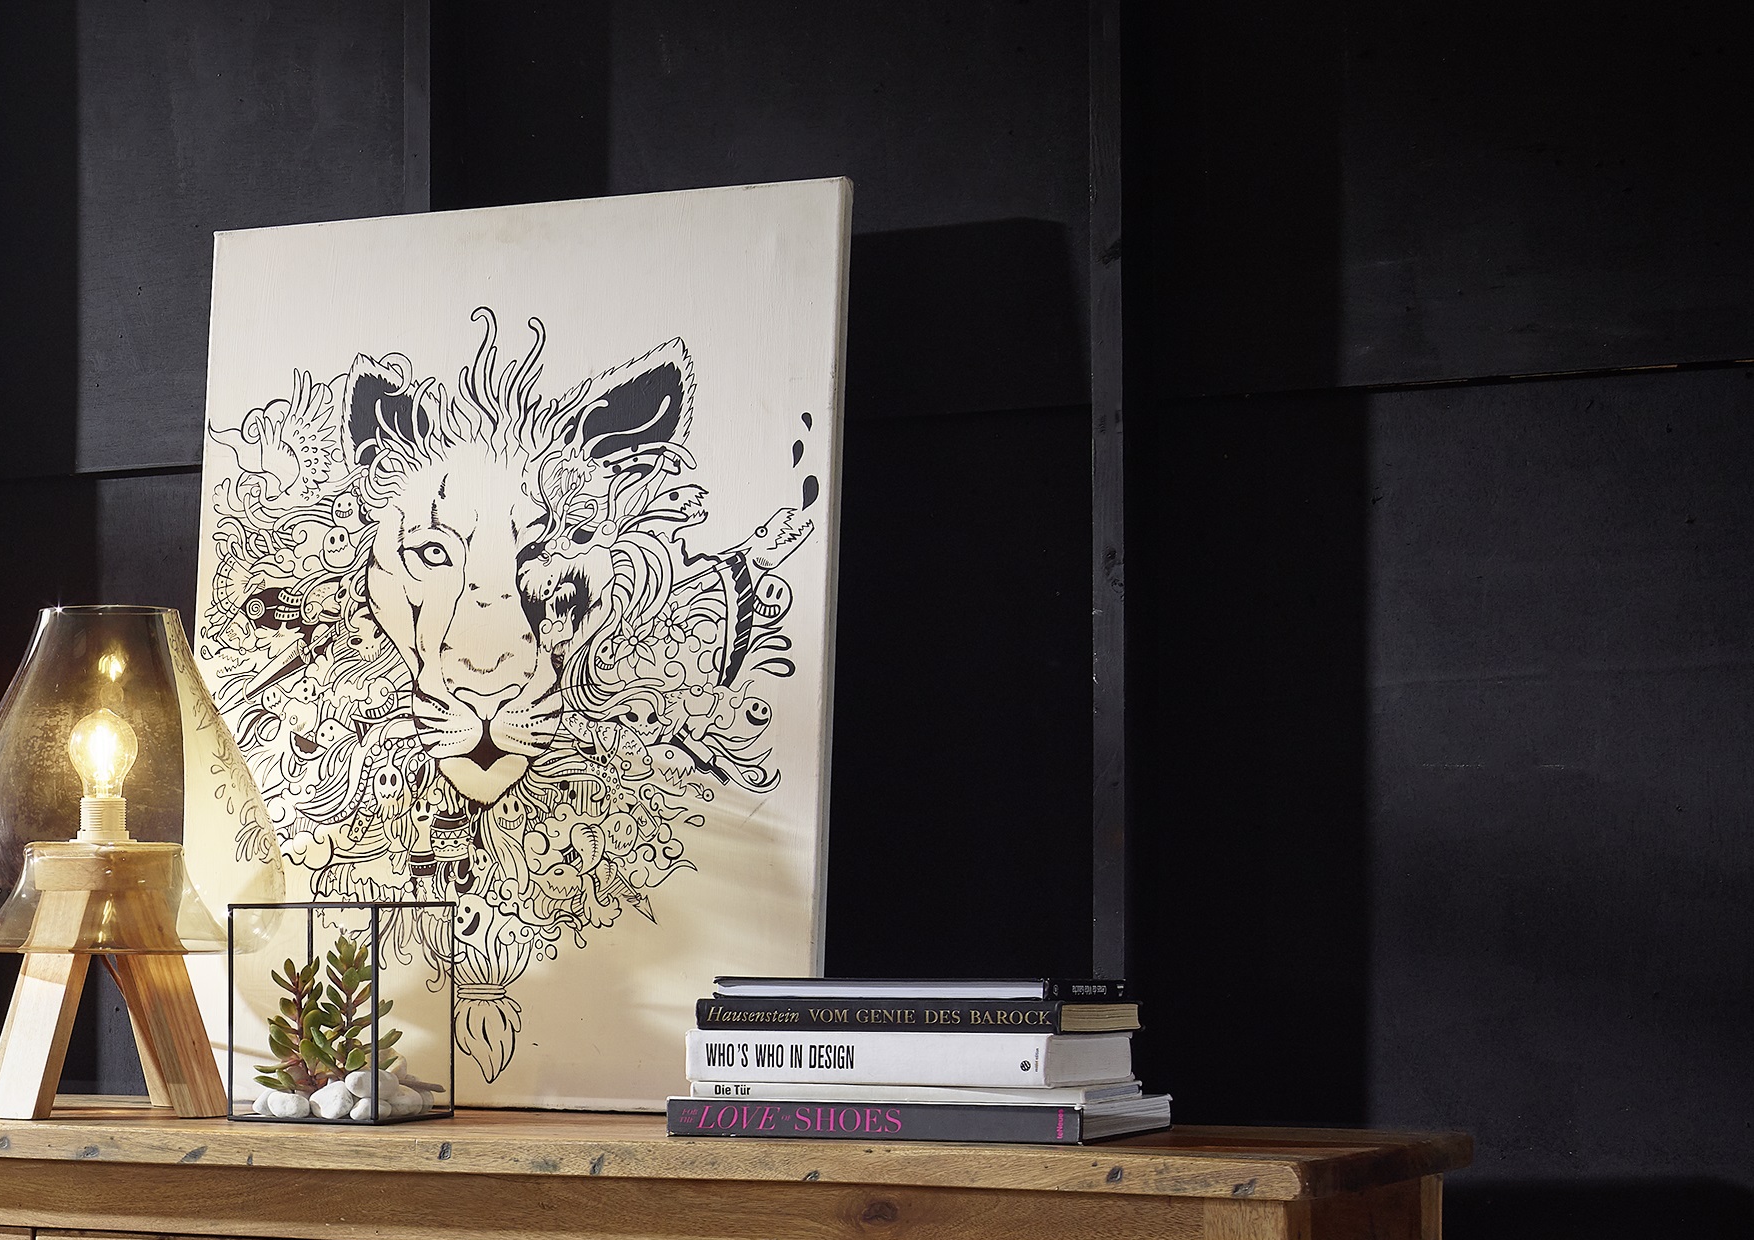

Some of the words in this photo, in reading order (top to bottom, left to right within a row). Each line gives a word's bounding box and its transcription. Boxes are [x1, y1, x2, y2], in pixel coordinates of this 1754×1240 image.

[706, 1005, 800, 1024] Hausenstein
[808, 1008, 849, 1024] VOM
[855, 1008, 917, 1025] GENIE
[924, 1009, 962, 1025] DES
[969, 1009, 1053, 1026] BAROCK
[705, 1042, 749, 1068] WHO'S
[754, 1043, 785, 1069] WHO
[789, 1044, 804, 1069] IN
[808, 1044, 855, 1070] DESIGN
[714, 1084, 732, 1096] Die
[733, 1084, 751, 1096] Tür
[695, 1105, 781, 1130] LOVE
[793, 1106, 902, 1134] SHOES
